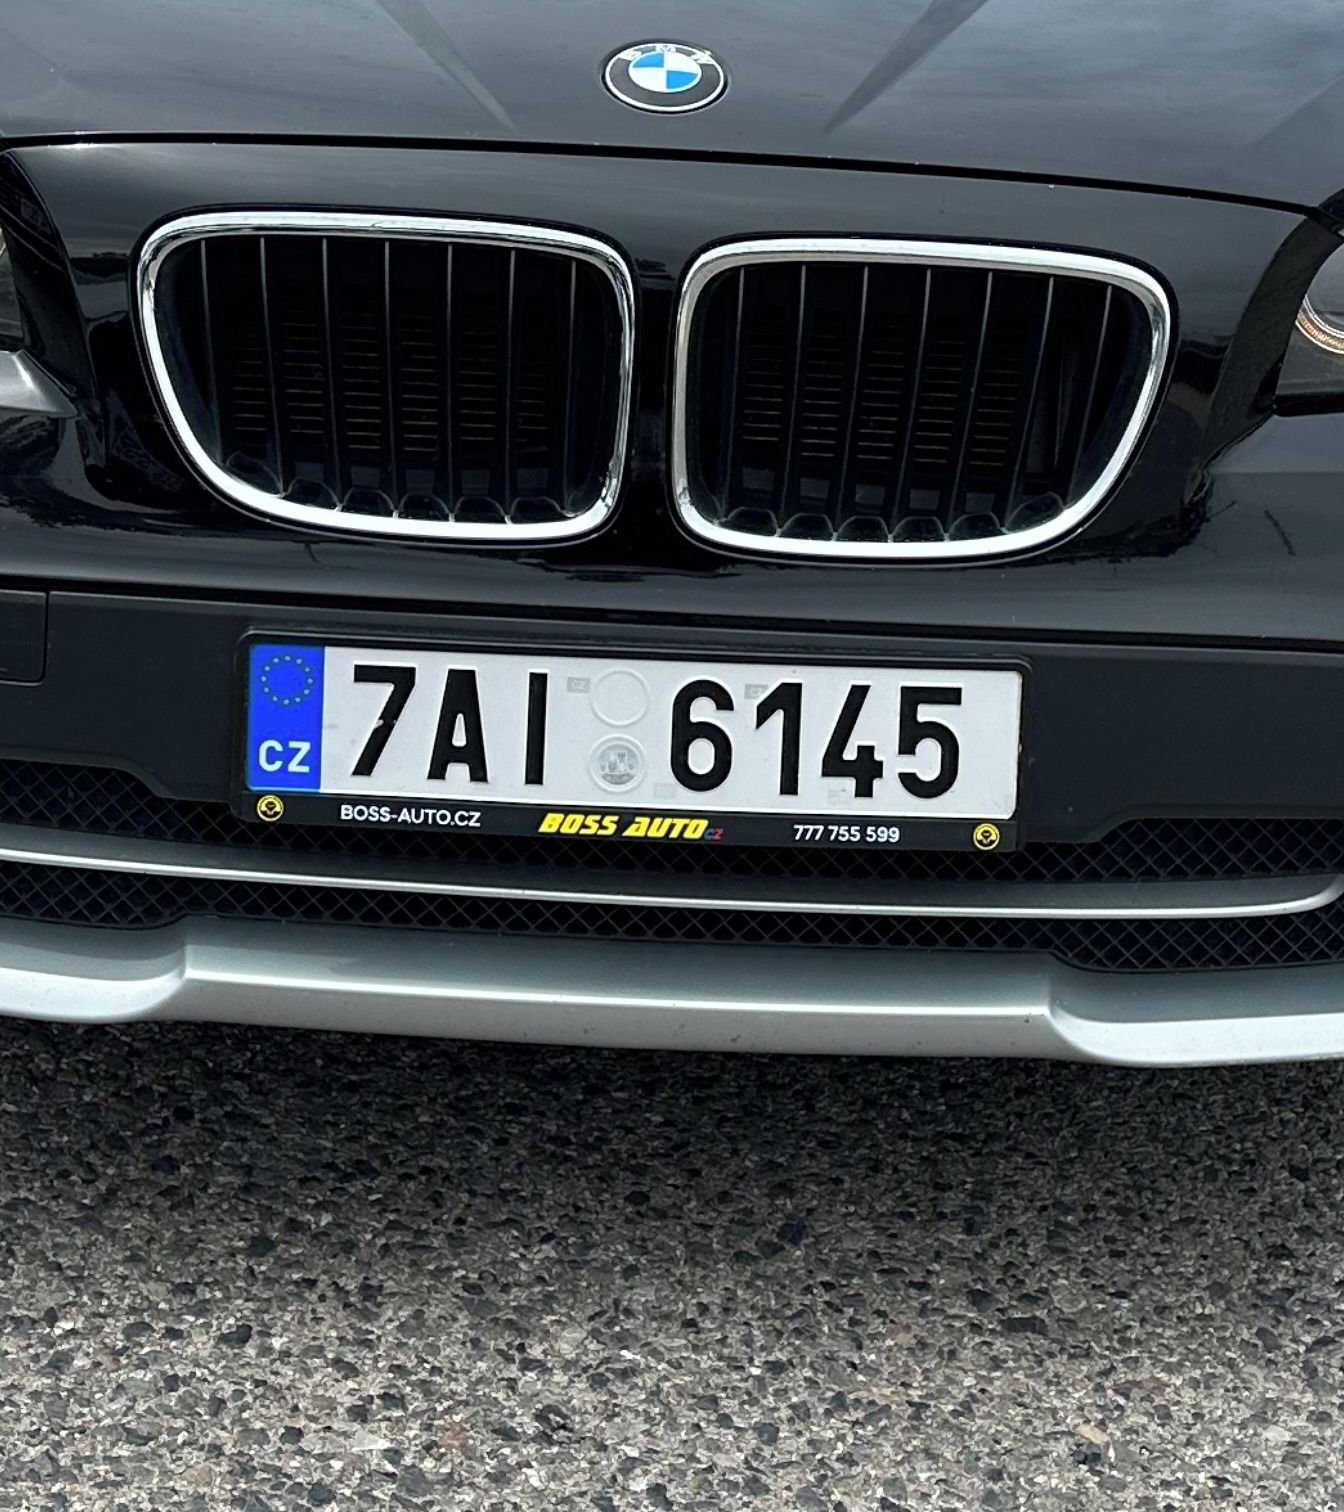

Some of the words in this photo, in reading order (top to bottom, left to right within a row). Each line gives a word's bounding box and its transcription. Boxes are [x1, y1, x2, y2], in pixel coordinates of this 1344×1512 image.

[351, 663, 549, 786] 7AI
[670, 678, 963, 799] 6145
[258, 739, 312, 774] CZ
[340, 803, 482, 828] BOSS-AUTO.CZ
[538, 812, 619, 836] BOSS
[622, 816, 709, 839] AUTO
[793, 824, 825, 841] 777
[828, 825, 861, 842] 755
[865, 826, 900, 843] 599
